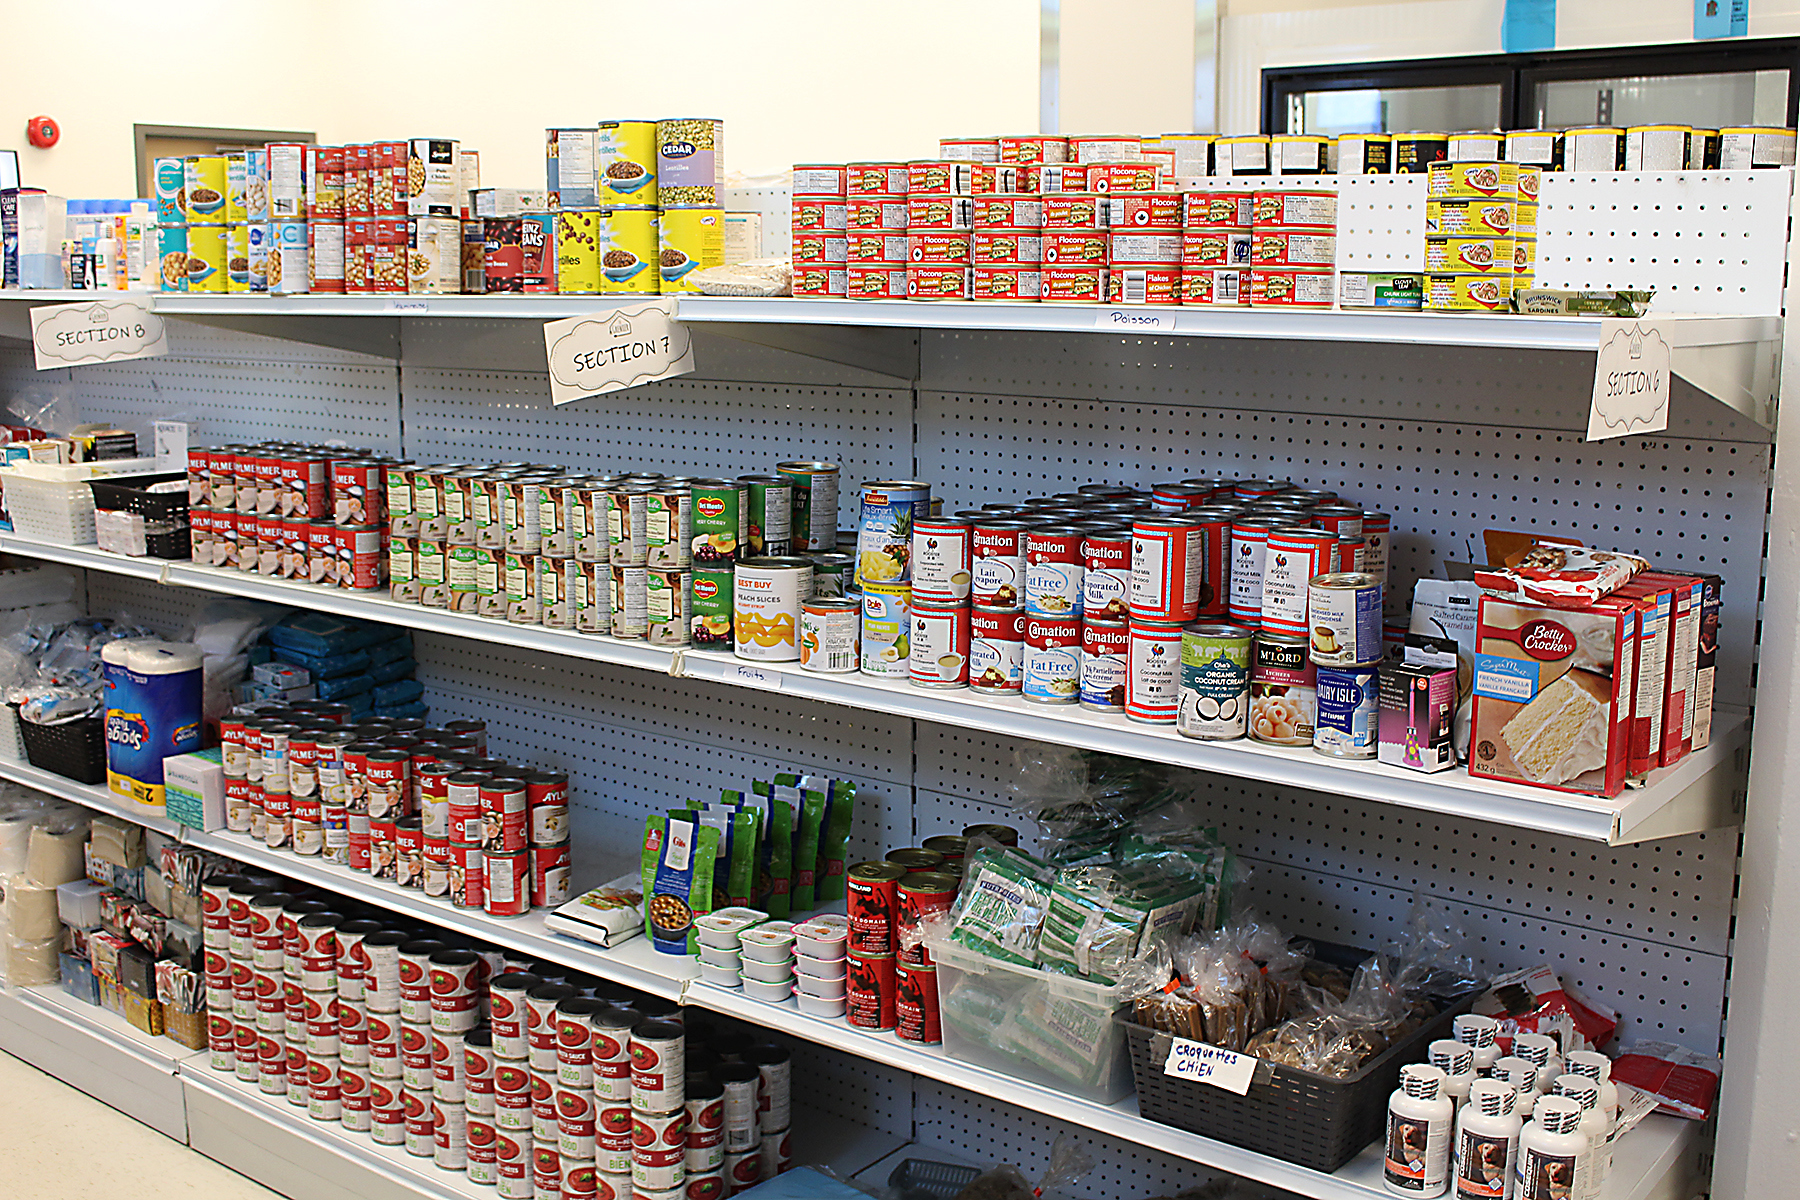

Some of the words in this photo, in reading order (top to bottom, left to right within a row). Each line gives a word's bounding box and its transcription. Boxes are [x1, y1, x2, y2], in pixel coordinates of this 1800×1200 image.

[662, 144, 692, 155] CEDAR
[1064, 170, 1084, 178] Flakes
[1110, 167, 1136, 175] Flocons
[1148, 274, 1169, 282] Flakes
[1525, 294, 1562, 305] BRUNSWICK
[1110, 311, 1160, 327] Poisson
[56, 324, 132, 348] SECTION
[134, 324, 146, 339] 8
[572, 341, 657, 372] SECTION
[660, 336, 670, 354] 7
[1607, 371, 1650, 398] SECTION
[1654, 369, 1660, 394] 6
[870, 506, 892, 514] Smart
[192, 516, 212, 527] AYLM
[980, 568, 995, 577] Lait
[738, 578, 753, 588] BEST
[754, 580, 772, 589] BUY
[1038, 577, 1062, 588] Free
[1264, 580, 1285, 588] Coconut
[738, 594, 756, 602] PEACH
[867, 599, 882, 609] Dole
[1433, 610, 1450, 620] Salted
[972, 617, 998, 630] nation
[1462, 622, 1474, 630] salé
[1029, 622, 1076, 639] Carnation
[1084, 627, 1128, 645] Carnation
[1534, 625, 1565, 643] Betty
[1524, 636, 1568, 653] Crocker
[1260, 650, 1302, 663] M'LORD
[1031, 660, 1046, 672] Fat
[1048, 662, 1073, 672] Free
[1140, 668, 1162, 676] Coconut
[1265, 670, 1291, 678] LYCHEES
[1194, 676, 1226, 686] COCONUT
[1479, 674, 1503, 684] FRENCH
[1504, 678, 1530, 688] VANILLA
[1317, 684, 1335, 703] DAIRY
[1336, 688, 1357, 704] ISLE
[1478, 682, 1498, 692] VANILLE
[1500, 686, 1528, 696] FRANÇAISE
[108, 726, 142, 750] Sponge
[224, 730, 244, 740] AYLM
[1475, 762, 1490, 773] 432
[1490, 766, 1496, 774] g
[145, 788, 154, 802] 2
[227, 786, 248, 796] AYLM
[562, 1070, 580, 1080] GOOD
[501, 1115, 520, 1126] BIEN
[1459, 1134, 1469, 1177] COSEQUIN
[610, 1159, 632, 1169] BIEN
[1523, 1154, 1534, 1197] COSEQUIN
